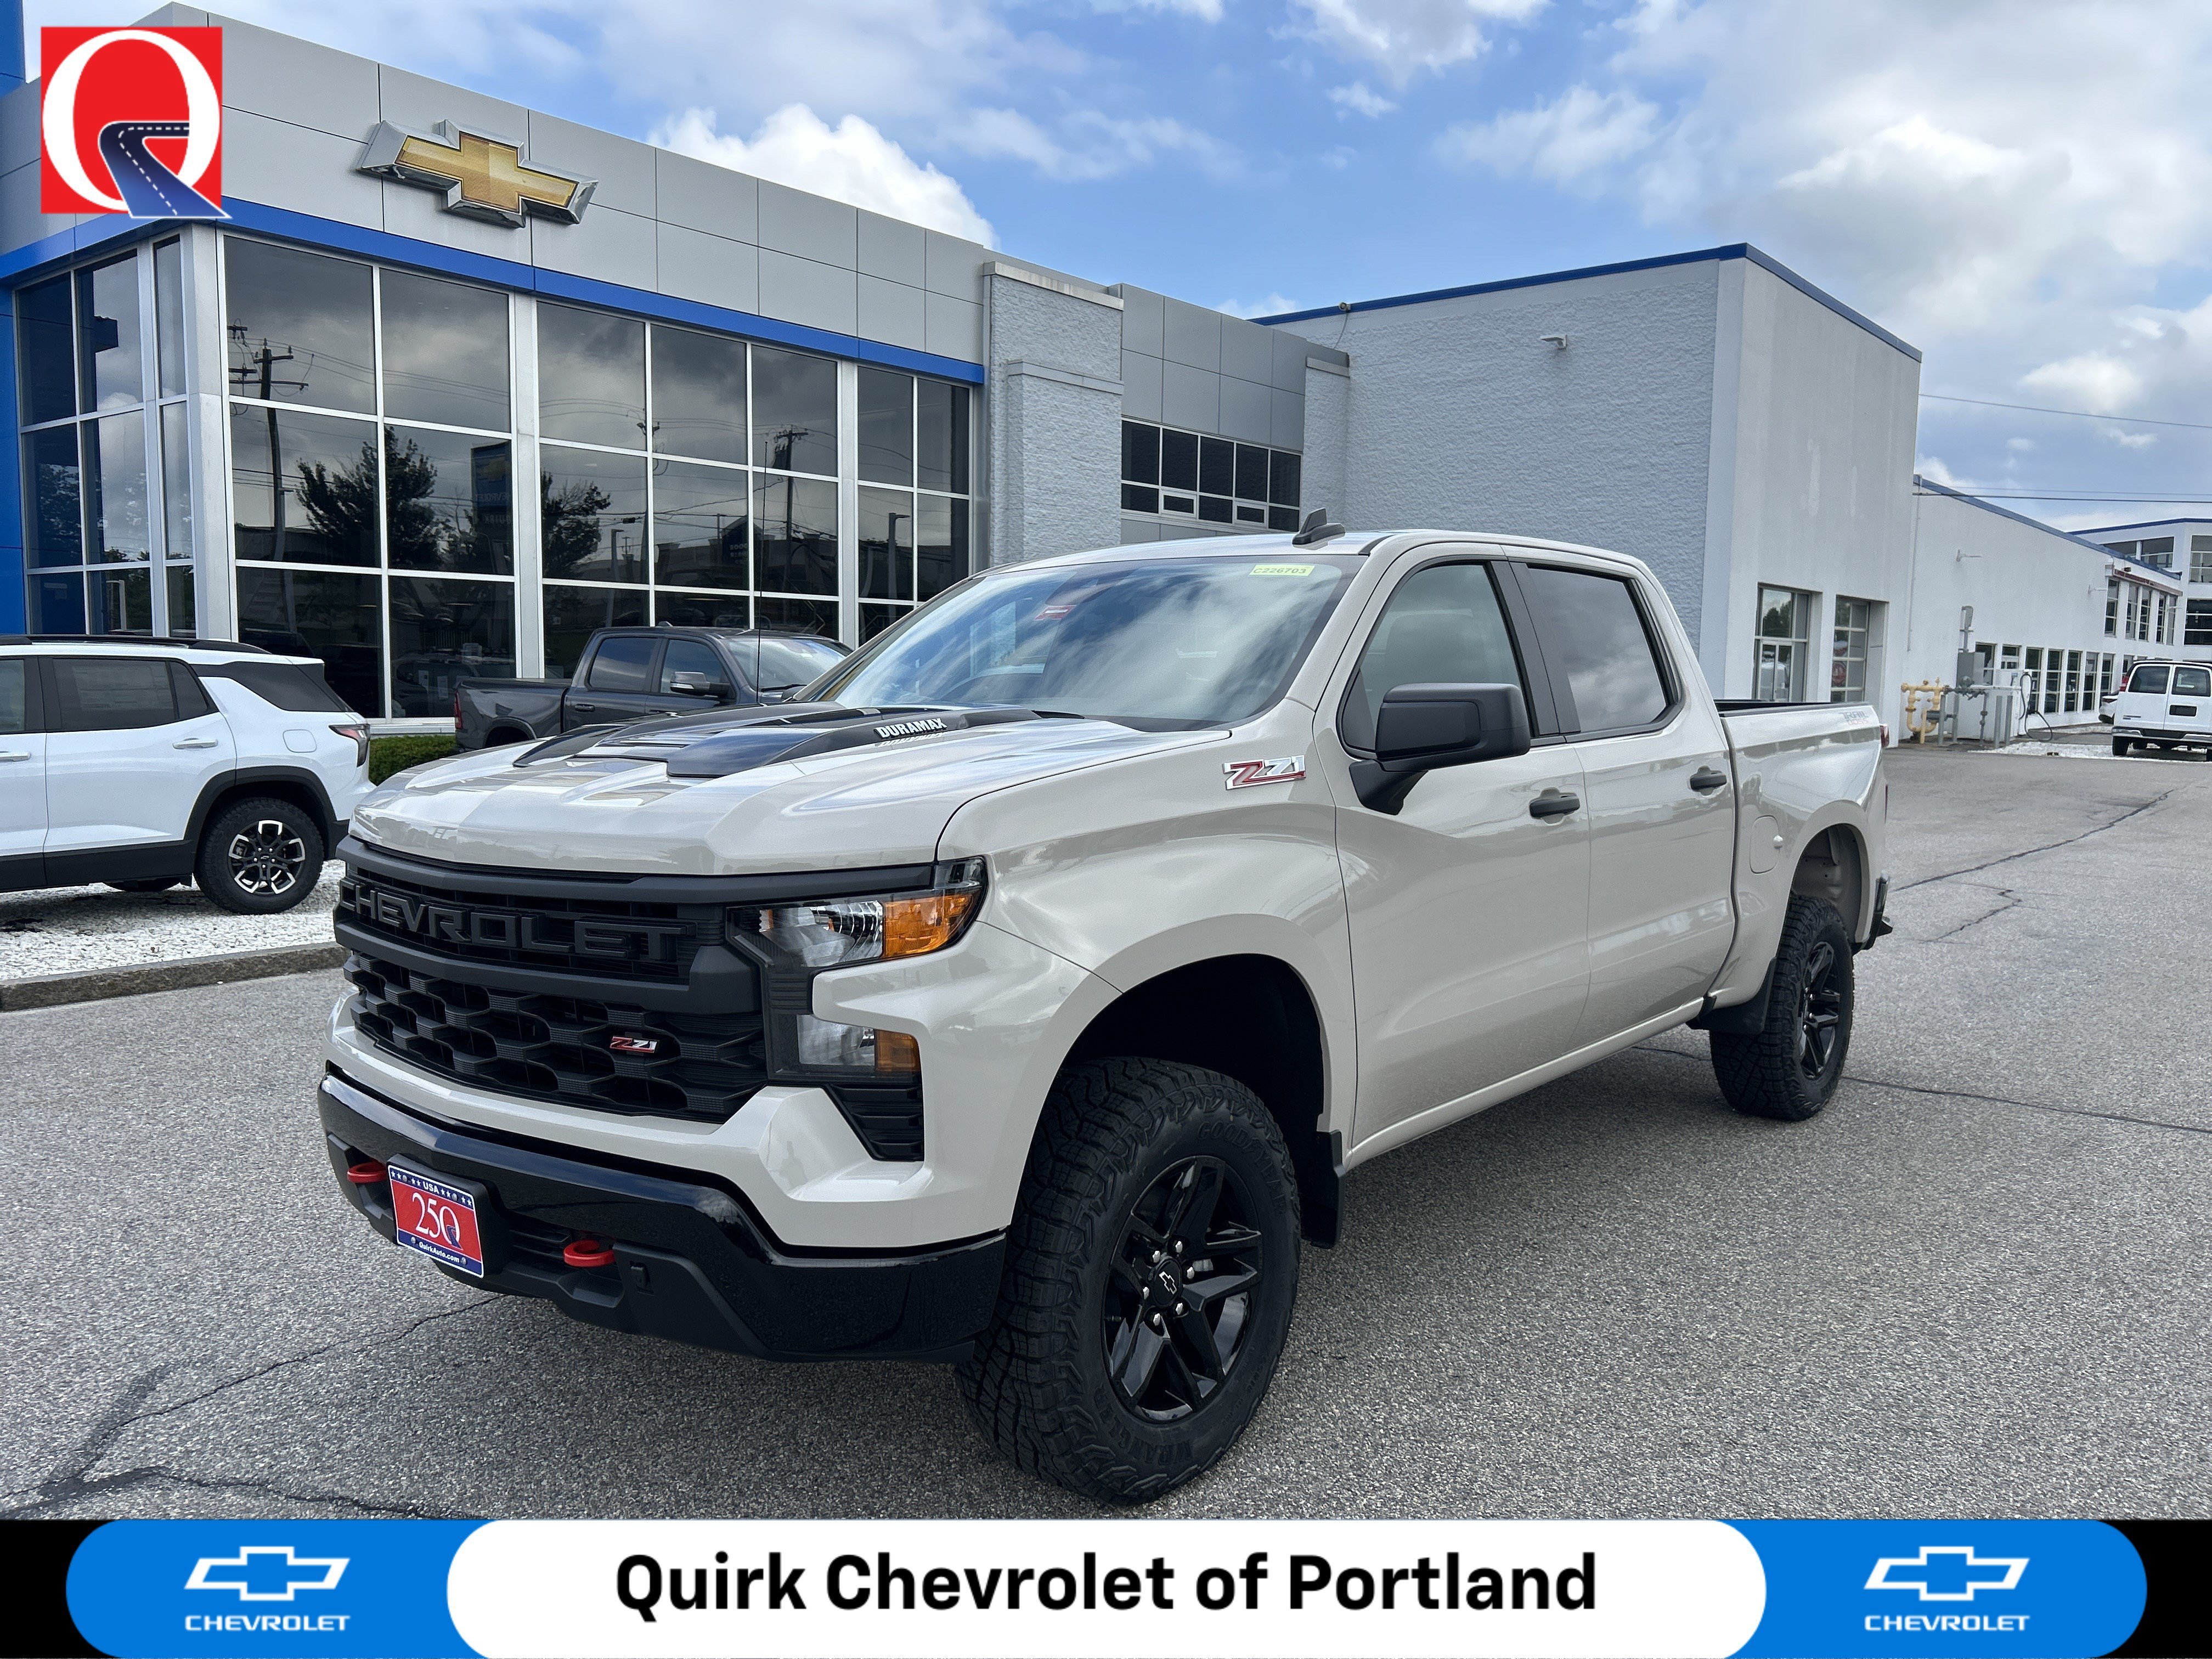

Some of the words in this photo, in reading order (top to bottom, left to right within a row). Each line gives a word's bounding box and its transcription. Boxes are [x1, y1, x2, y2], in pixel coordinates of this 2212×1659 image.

[876, 718, 947, 738] DURAMAX
[1222, 755, 1306, 790] Z71
[339, 878, 696, 962] CHEVROLET
[610, 1036, 657, 1053] Z71
[1198, 1121, 1287, 1214] GOODYEAR
[422, 1181, 439, 1194] USA
[419, 1242, 460, 1263] QuirkAuto.com
